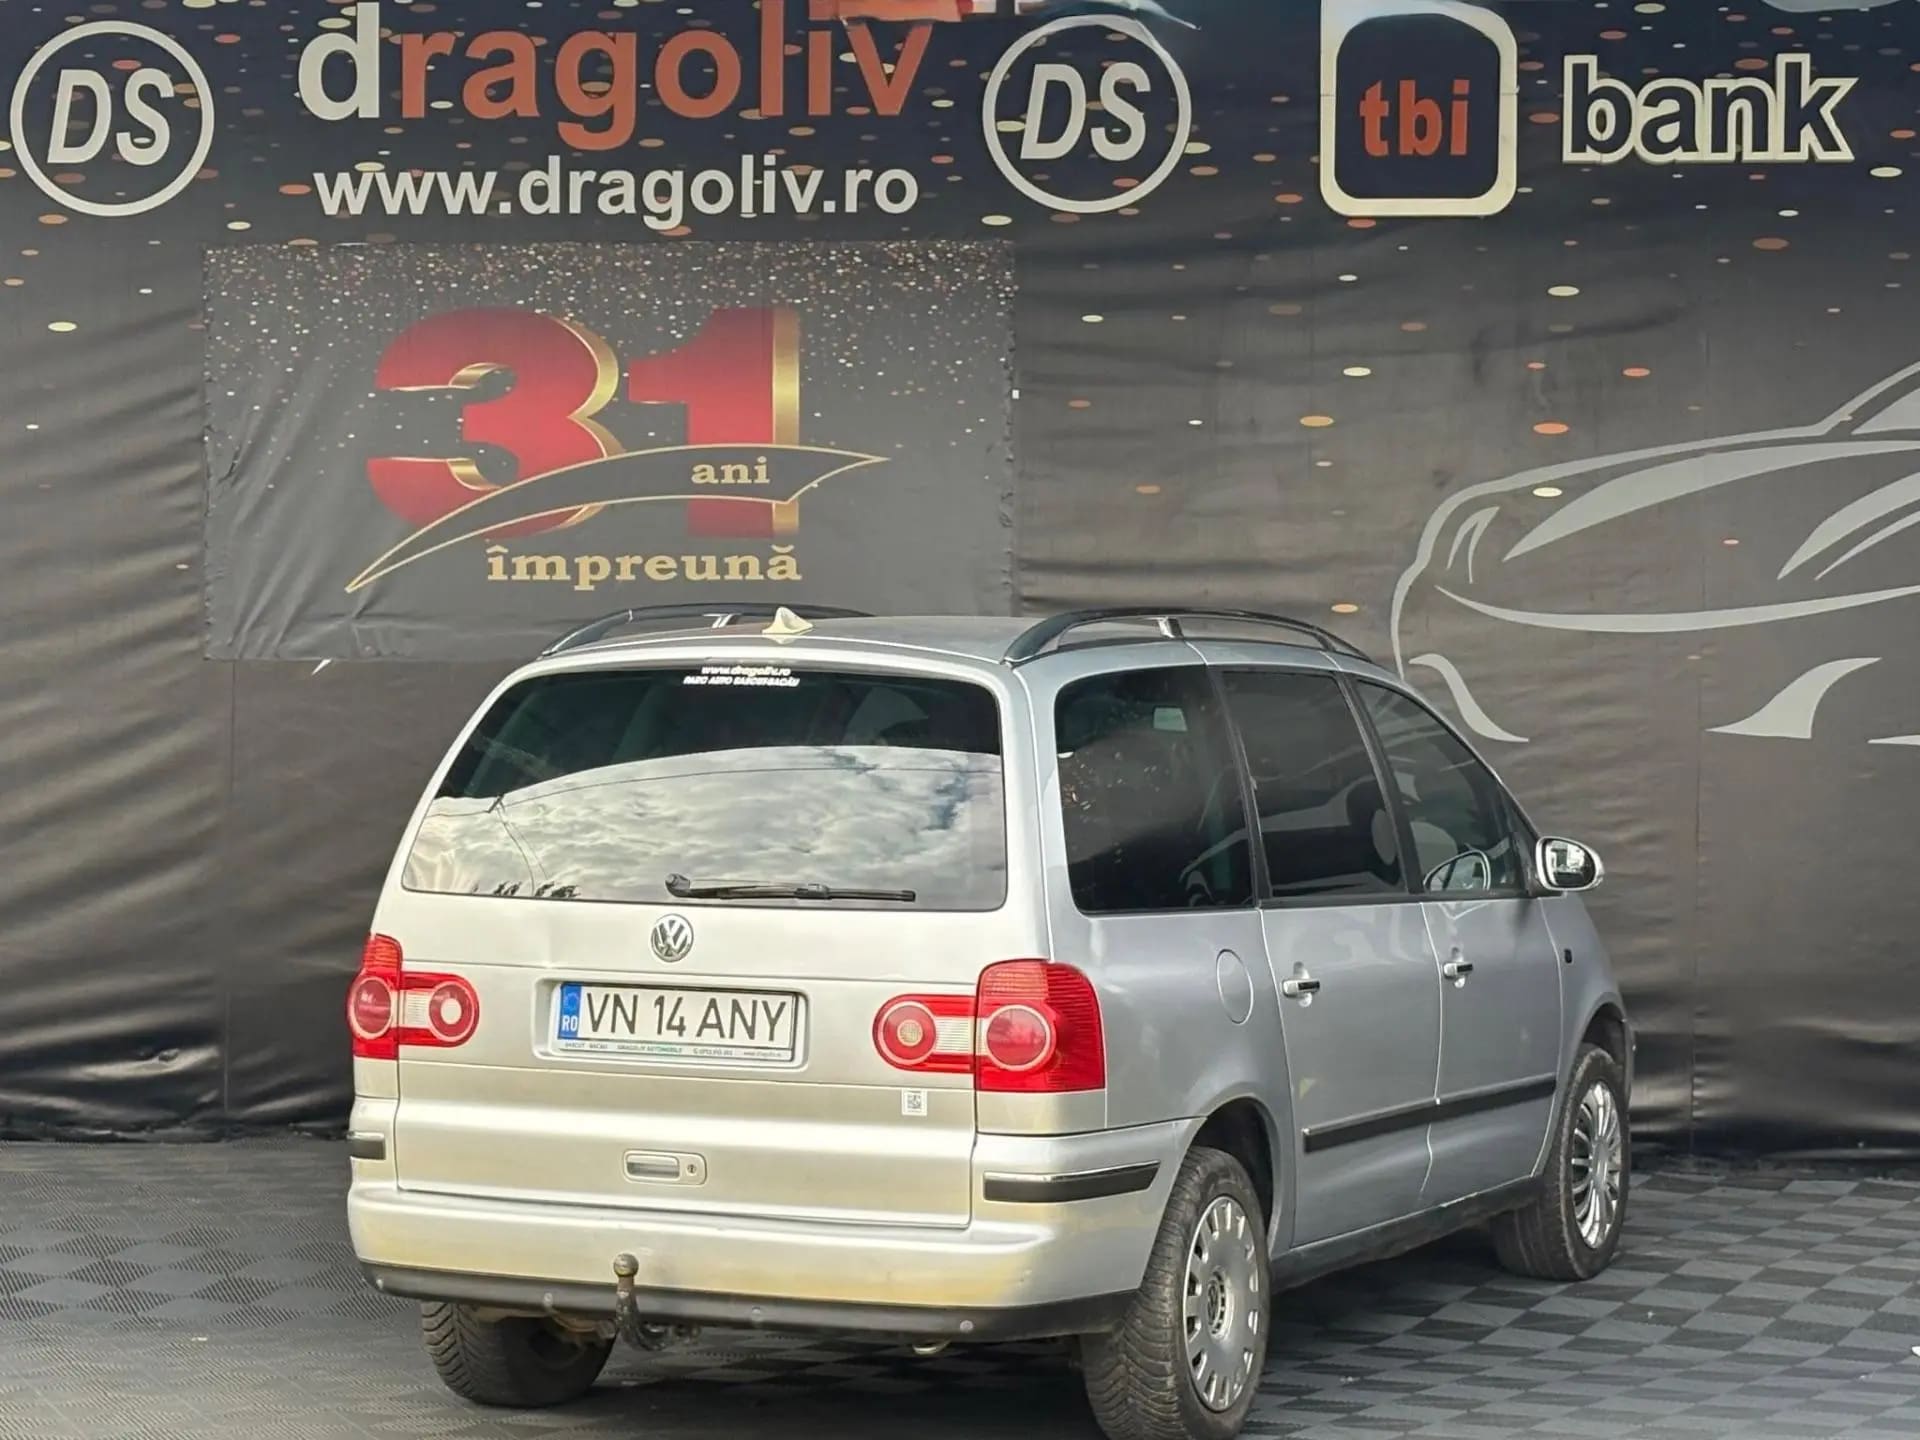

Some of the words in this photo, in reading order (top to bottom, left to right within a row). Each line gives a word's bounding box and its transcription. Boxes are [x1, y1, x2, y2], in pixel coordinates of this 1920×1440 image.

[298, 1, 935, 150] dragoliv
[1020, 63, 1152, 162] DS
[1562, 53, 1858, 164] bank
[47, 68, 174, 165] DS
[1359, 79, 1469, 157] tbi
[312, 154, 919, 231] www.dragoliv.ro
[367, 305, 800, 540] 31
[690, 456, 771, 485] ani
[485, 544, 803, 591] împreună
[562, 1014, 578, 1032] RO
[586, 992, 639, 1035] VN
[653, 995, 687, 1037] 14
[696, 998, 787, 1042] ANY
